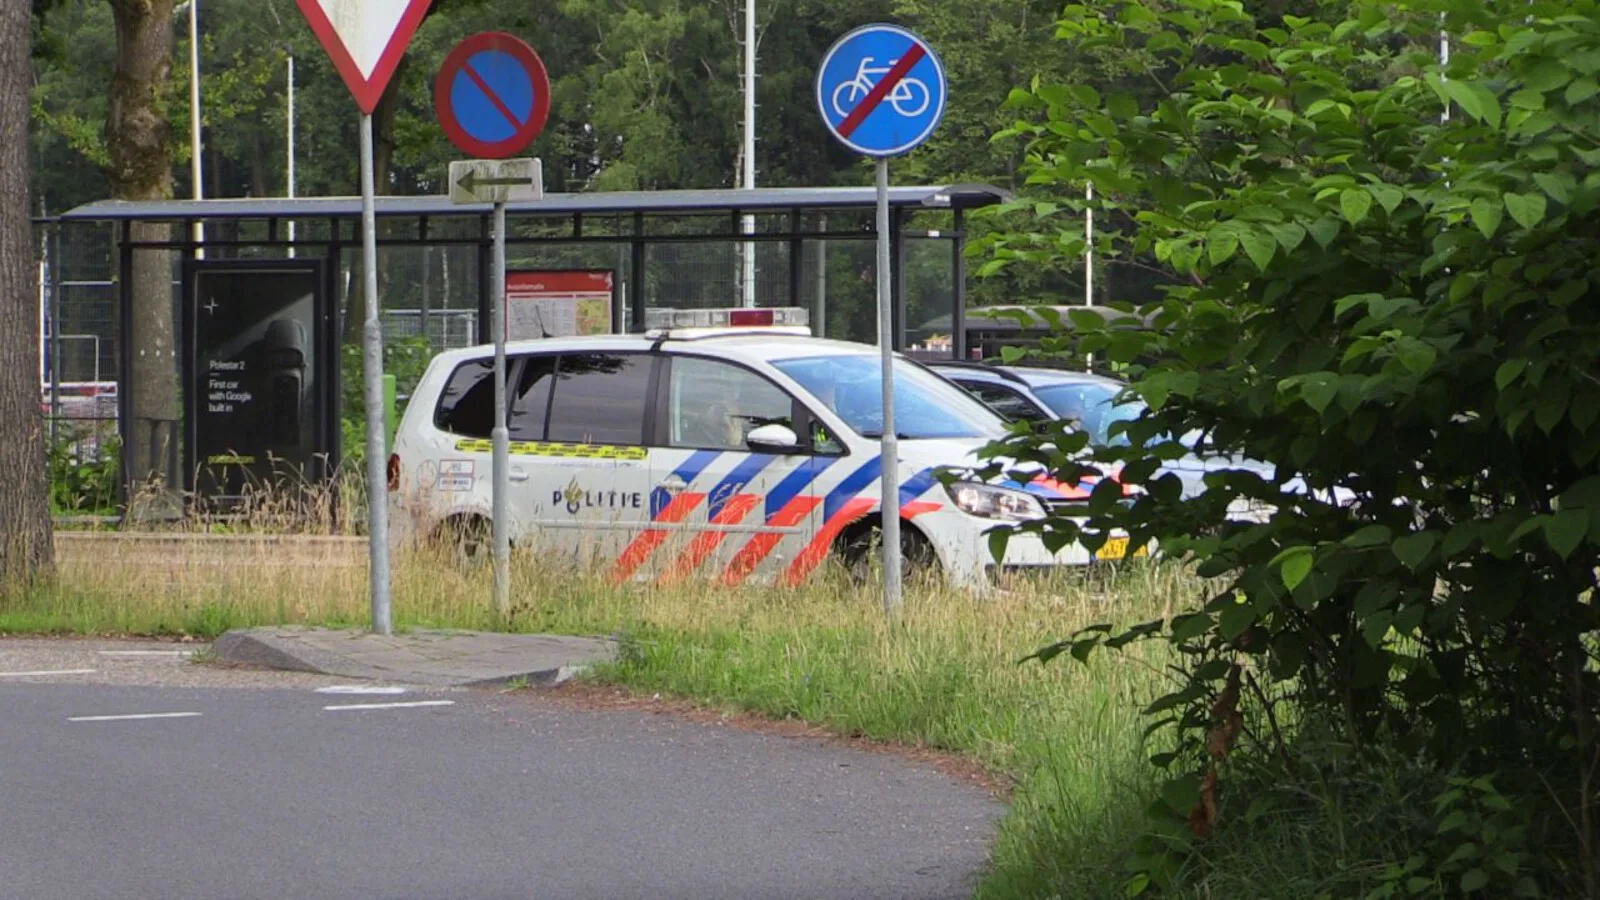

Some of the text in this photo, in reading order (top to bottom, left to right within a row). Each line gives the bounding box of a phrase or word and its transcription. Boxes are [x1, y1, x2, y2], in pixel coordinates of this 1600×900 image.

[209, 360, 239, 370] Polestar
[209, 379, 239, 389] First car
[208, 391, 252, 403] with Google
[208, 403, 234, 412] built in
[553, 489, 641, 514] POLITIE
